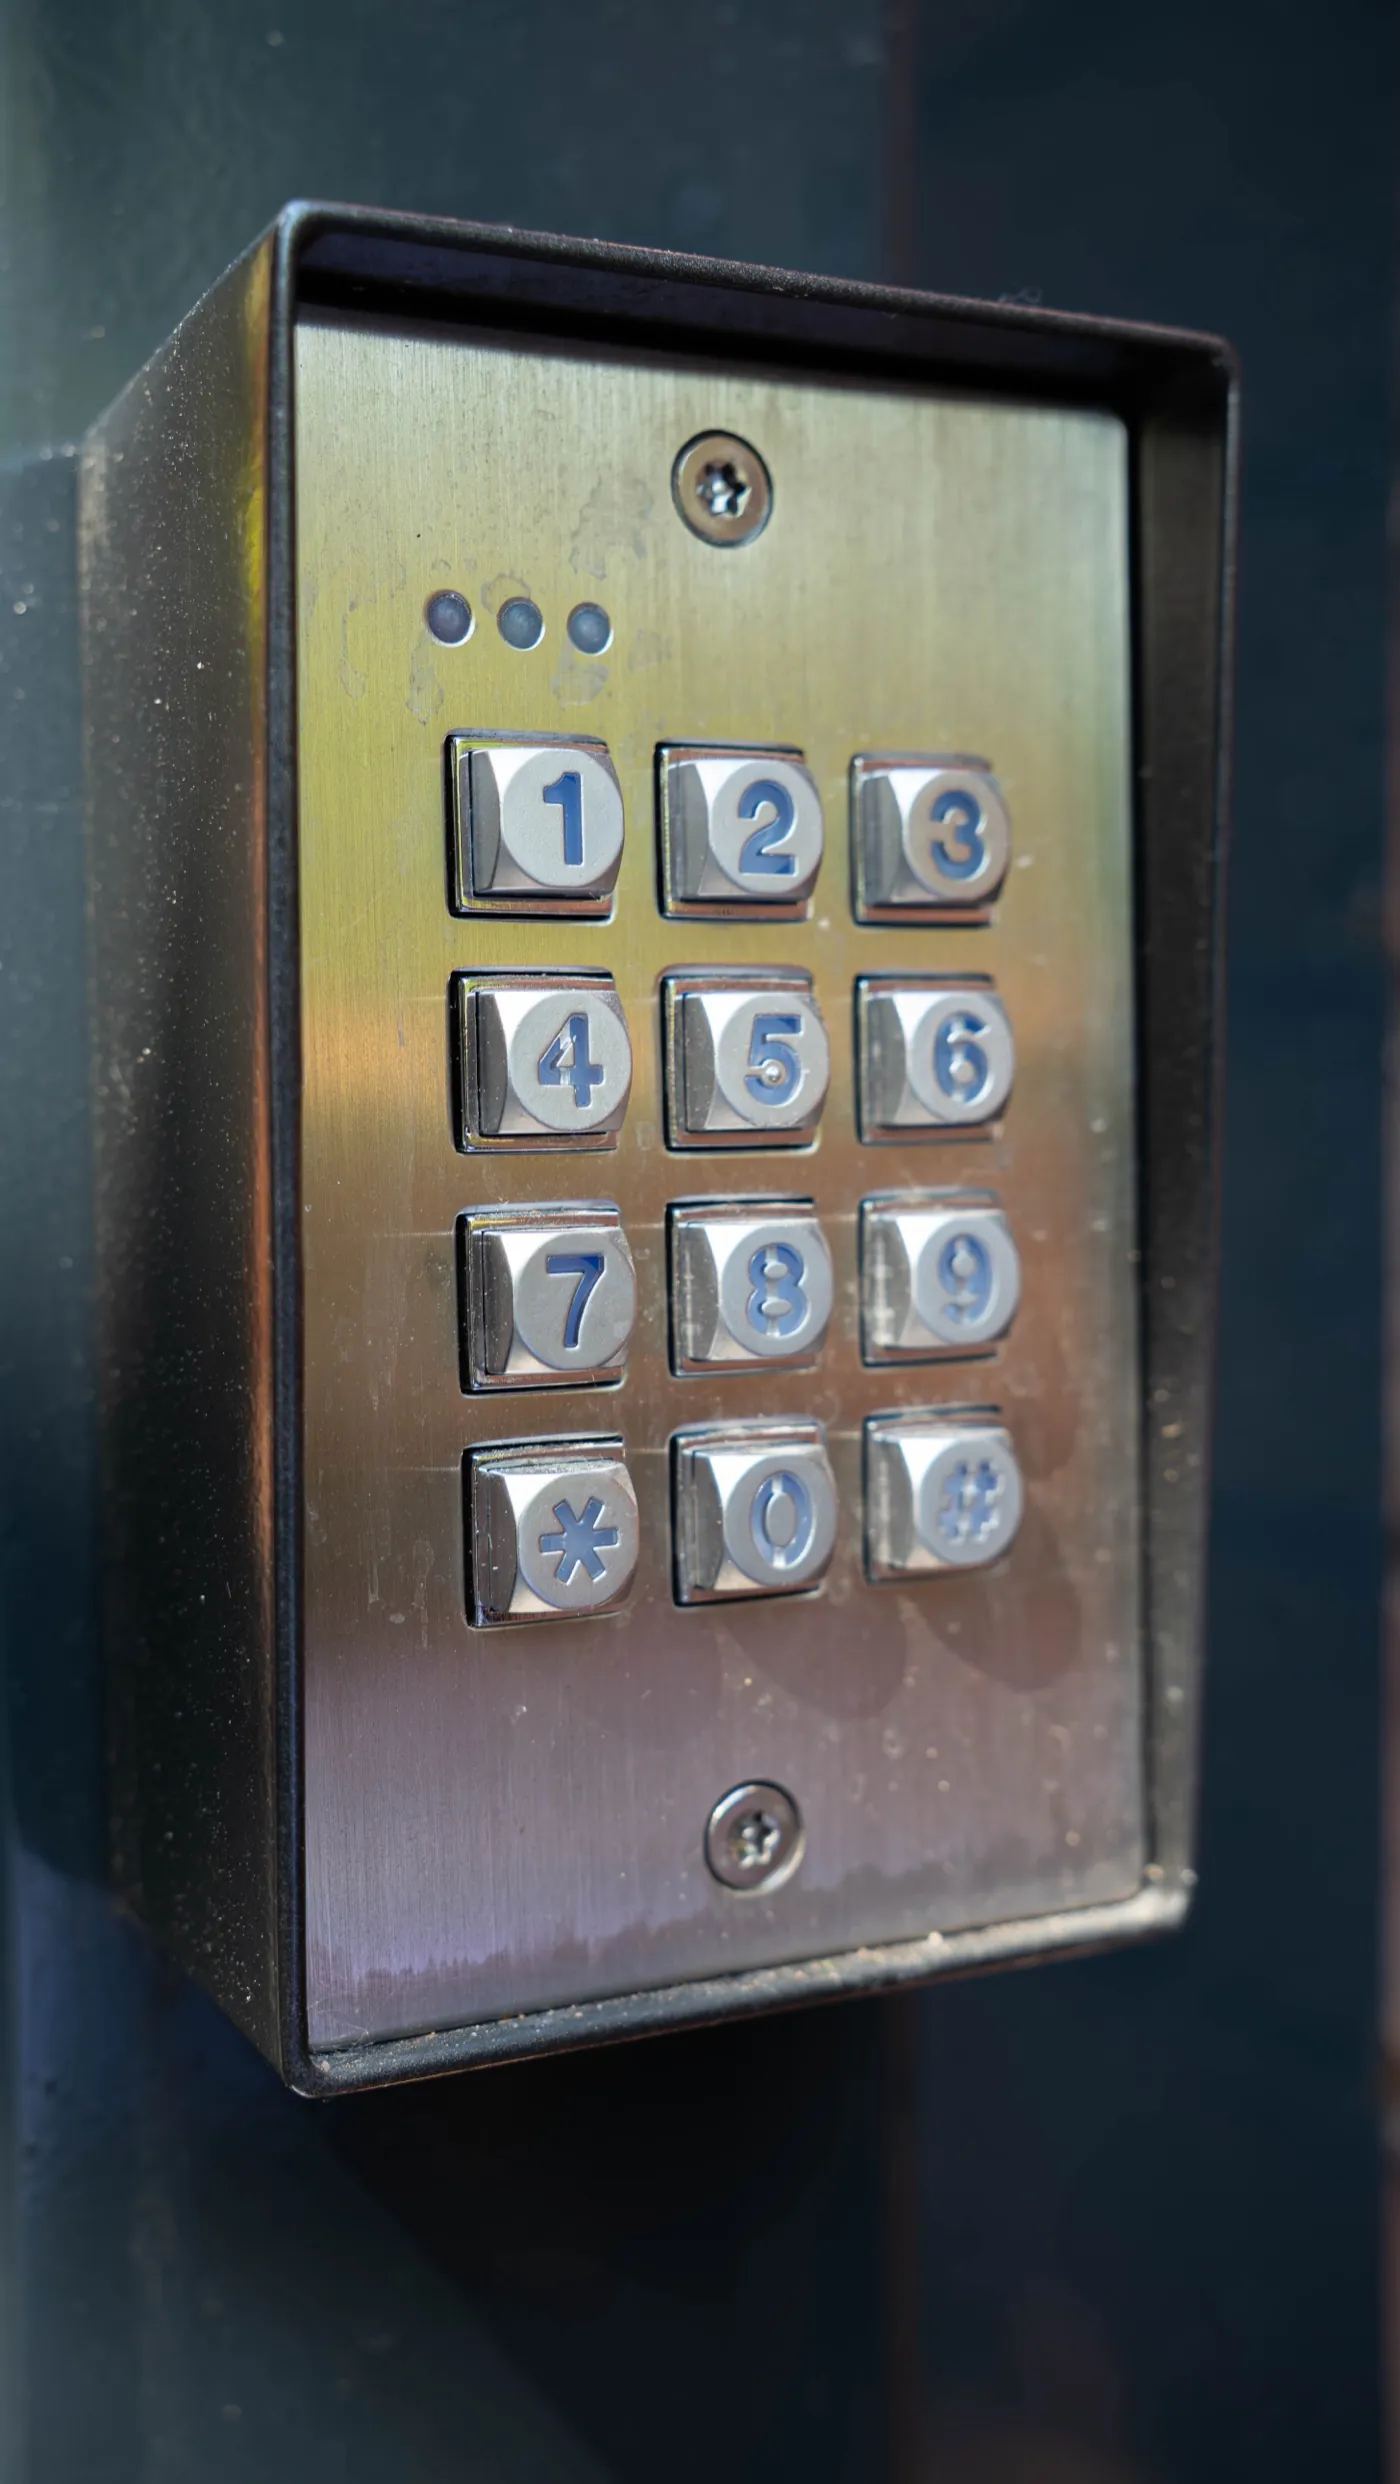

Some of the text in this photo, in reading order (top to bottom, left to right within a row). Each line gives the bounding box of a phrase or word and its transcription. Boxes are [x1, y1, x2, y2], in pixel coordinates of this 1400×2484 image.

[543, 771, 584, 866] 1
[737, 779, 798, 876] 2
[930, 789, 989, 881] 3
[538, 1013, 604, 1108] 4
[743, 1014, 805, 1106] 5
[934, 1010, 993, 1105] 6
[547, 1254, 605, 1348] 7
[747, 1242, 810, 1338] 8
[937, 1233, 994, 1326] 9
[750, 1469, 814, 1570] 0
[937, 1459, 1004, 1544] #
